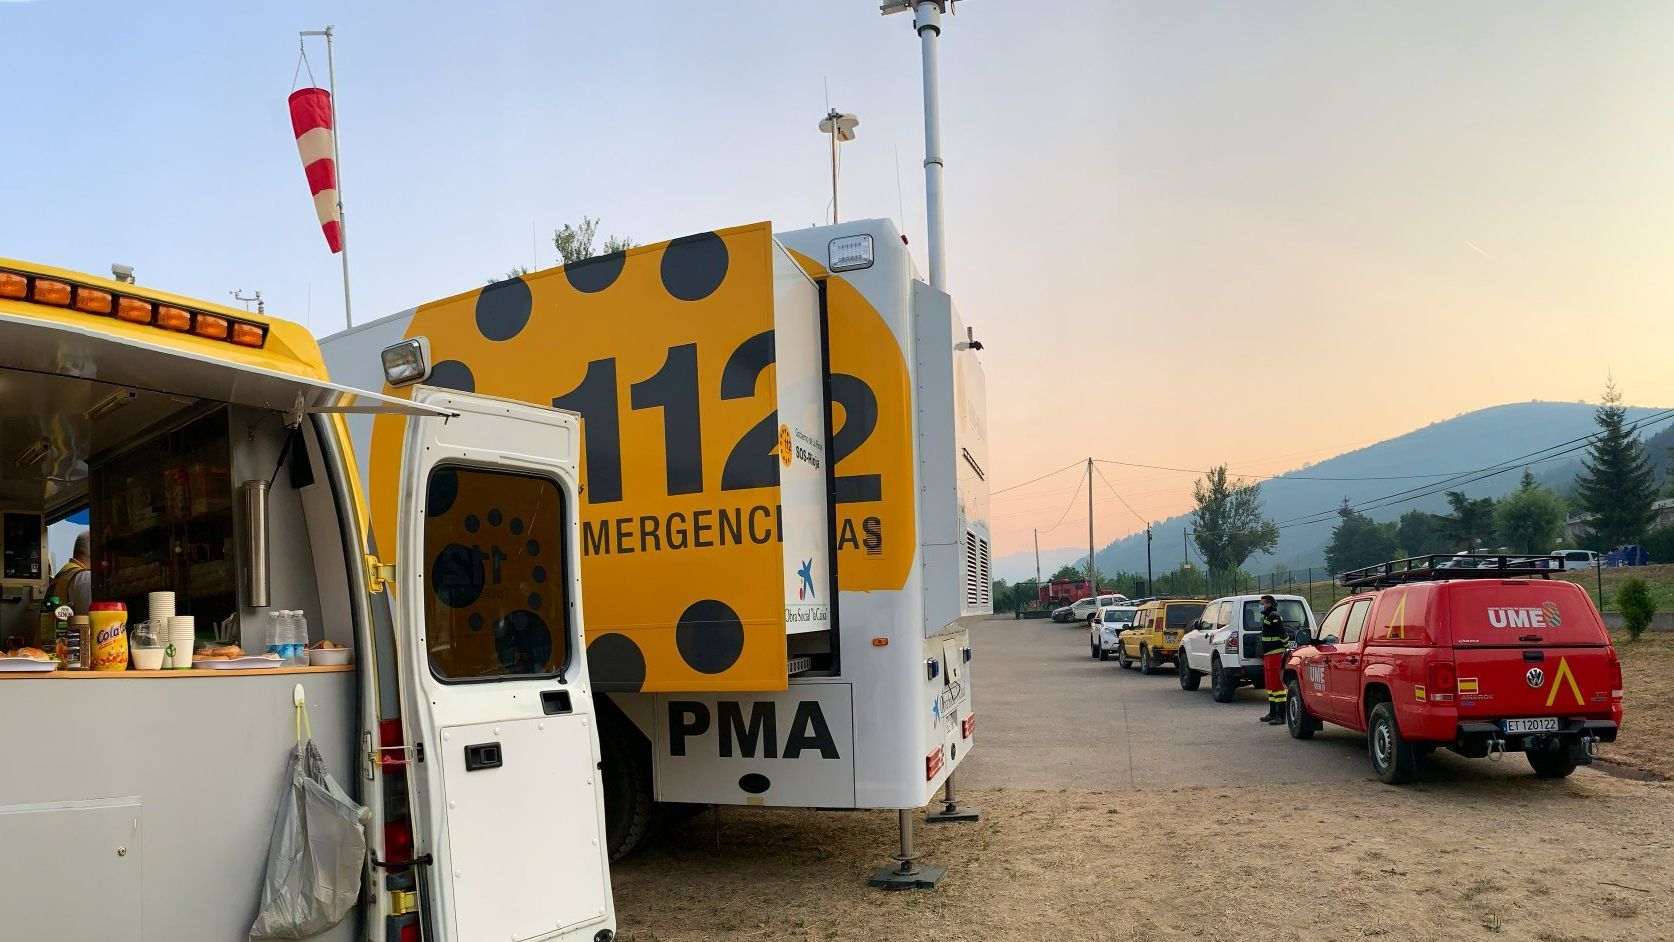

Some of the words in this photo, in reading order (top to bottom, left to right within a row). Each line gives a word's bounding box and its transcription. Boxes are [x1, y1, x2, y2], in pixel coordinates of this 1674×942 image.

[795, 446, 820, 470] SOS-Rioja
[583, 505, 883, 557] MERGENCIAS
[1487, 609, 1547, 628] UME
[1310, 666, 1325, 684] UME
[667, 700, 841, 759] PMA
[1508, 720, 1520, 732] ET
[1523, 719, 1556, 731] 120122
